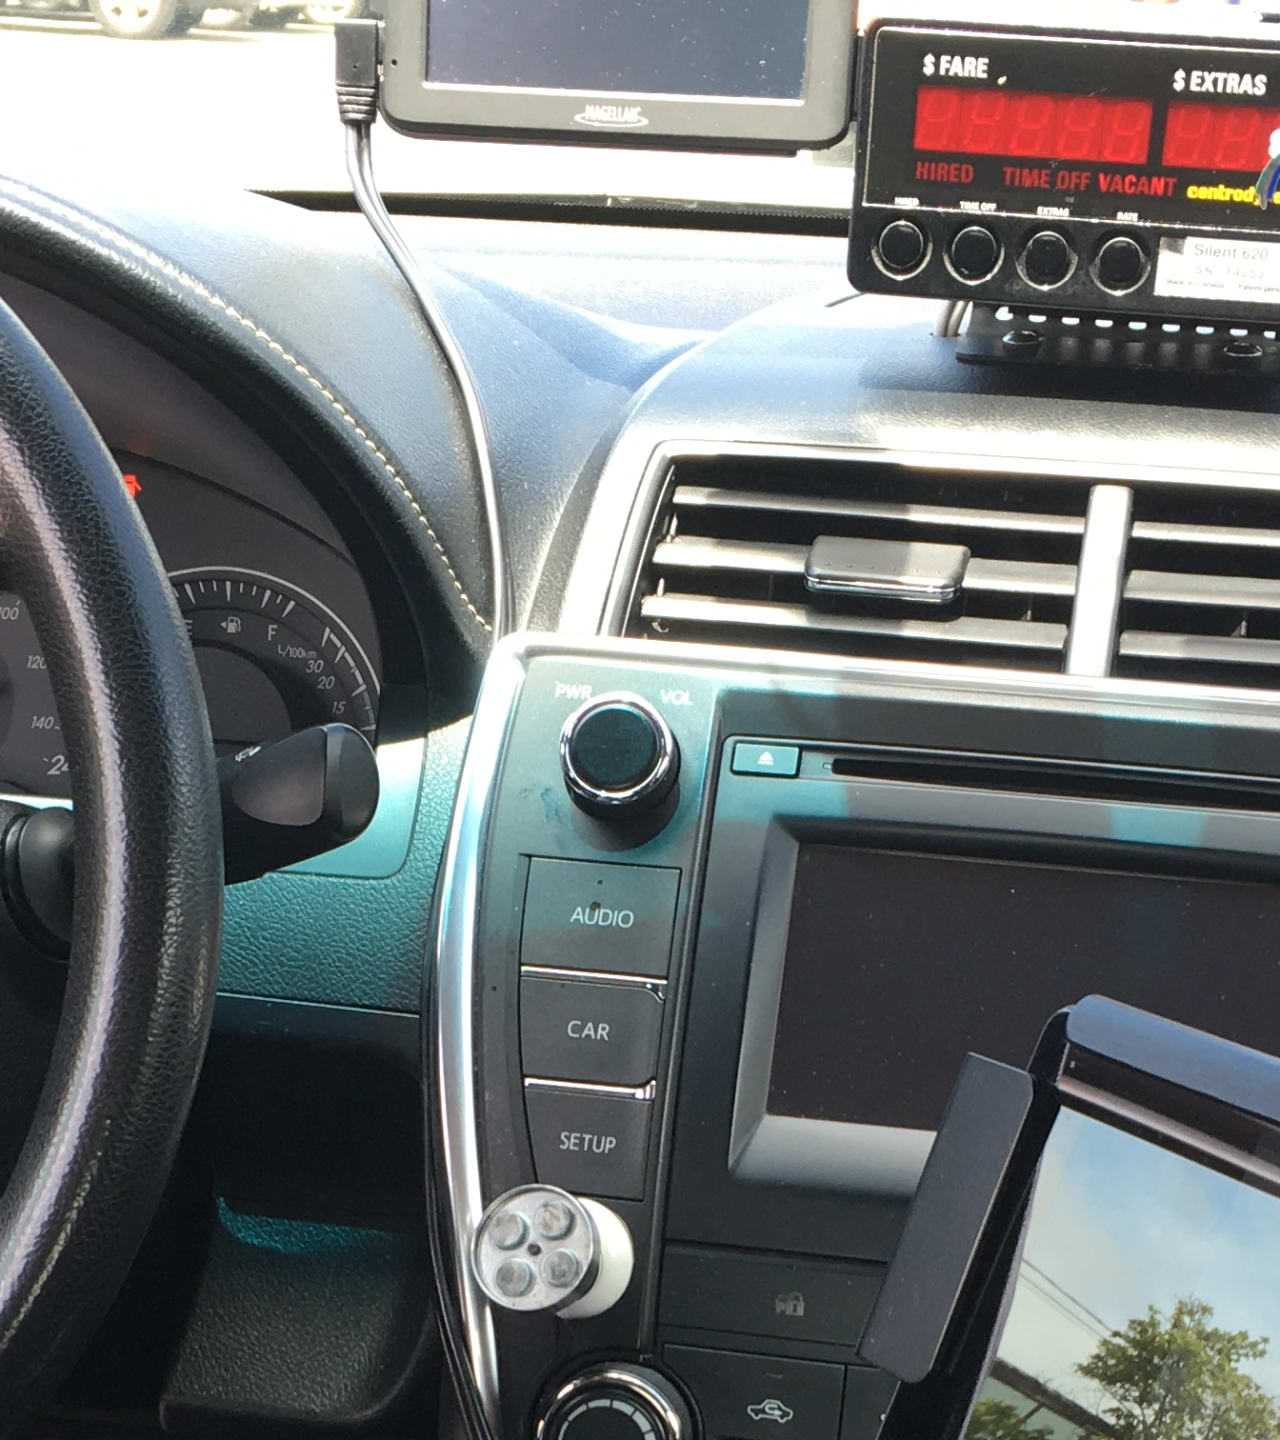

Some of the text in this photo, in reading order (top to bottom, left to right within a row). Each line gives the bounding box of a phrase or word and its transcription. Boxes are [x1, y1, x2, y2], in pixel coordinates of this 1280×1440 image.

[922, 53, 989, 78] $ FARE
[1172, 68, 1268, 96] $ EXTRAS
[915, 161, 974, 184] HIRED
[1003, 166, 1092, 191] TIME OFF
[1098, 172, 1178, 198] VACANT
[1037, 207, 1070, 217] EXTRAS
[1194, 243, 1237, 259] Silent
[268, 624, 278, 641] F
[277, 643, 317, 659] L/100km
[306, 660, 324, 673] 30
[317, 676, 335, 689] 20
[555, 682, 593, 701] PWR
[660, 689, 693, 706] VOL
[332, 701, 346, 714] 15
[31, 716, 54, 730] 140
[570, 906, 634, 929] AUDIO
[566, 1019, 609, 1042] CAR
[559, 1130, 617, 1155] SETUP
